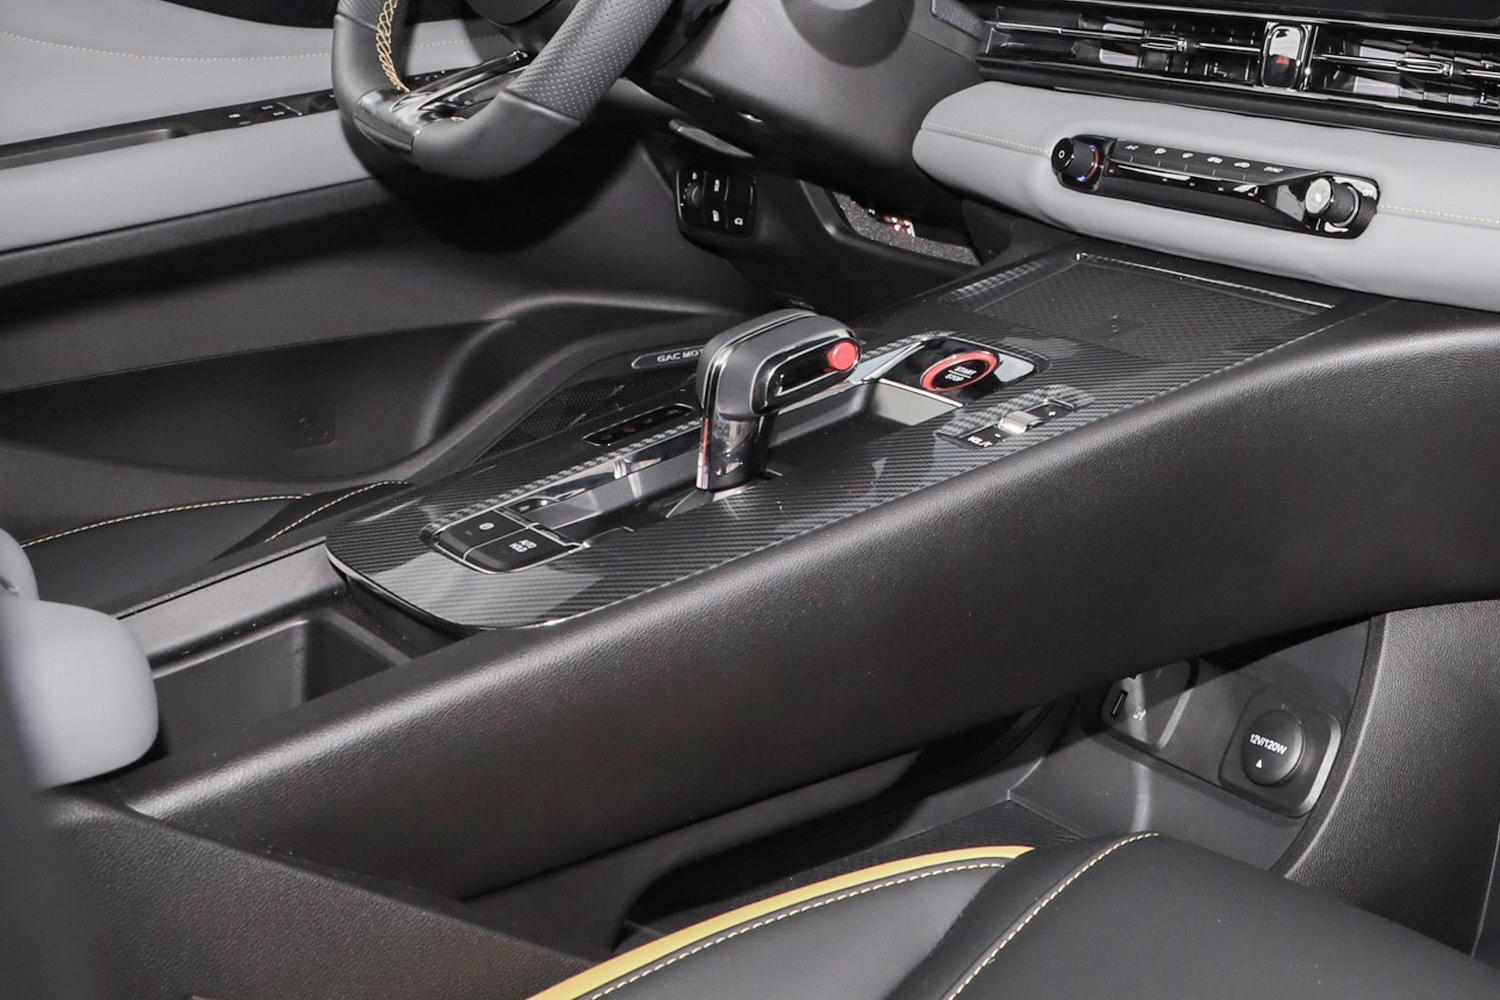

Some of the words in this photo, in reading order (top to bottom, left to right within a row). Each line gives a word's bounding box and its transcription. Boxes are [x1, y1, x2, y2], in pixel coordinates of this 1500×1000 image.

[656, 353, 681, 363] GAC
[682, 348, 704, 359] MOT
[954, 366, 977, 376] START
[944, 373, 965, 382] STOP
[1250, 733, 1288, 755] 12V/120W
